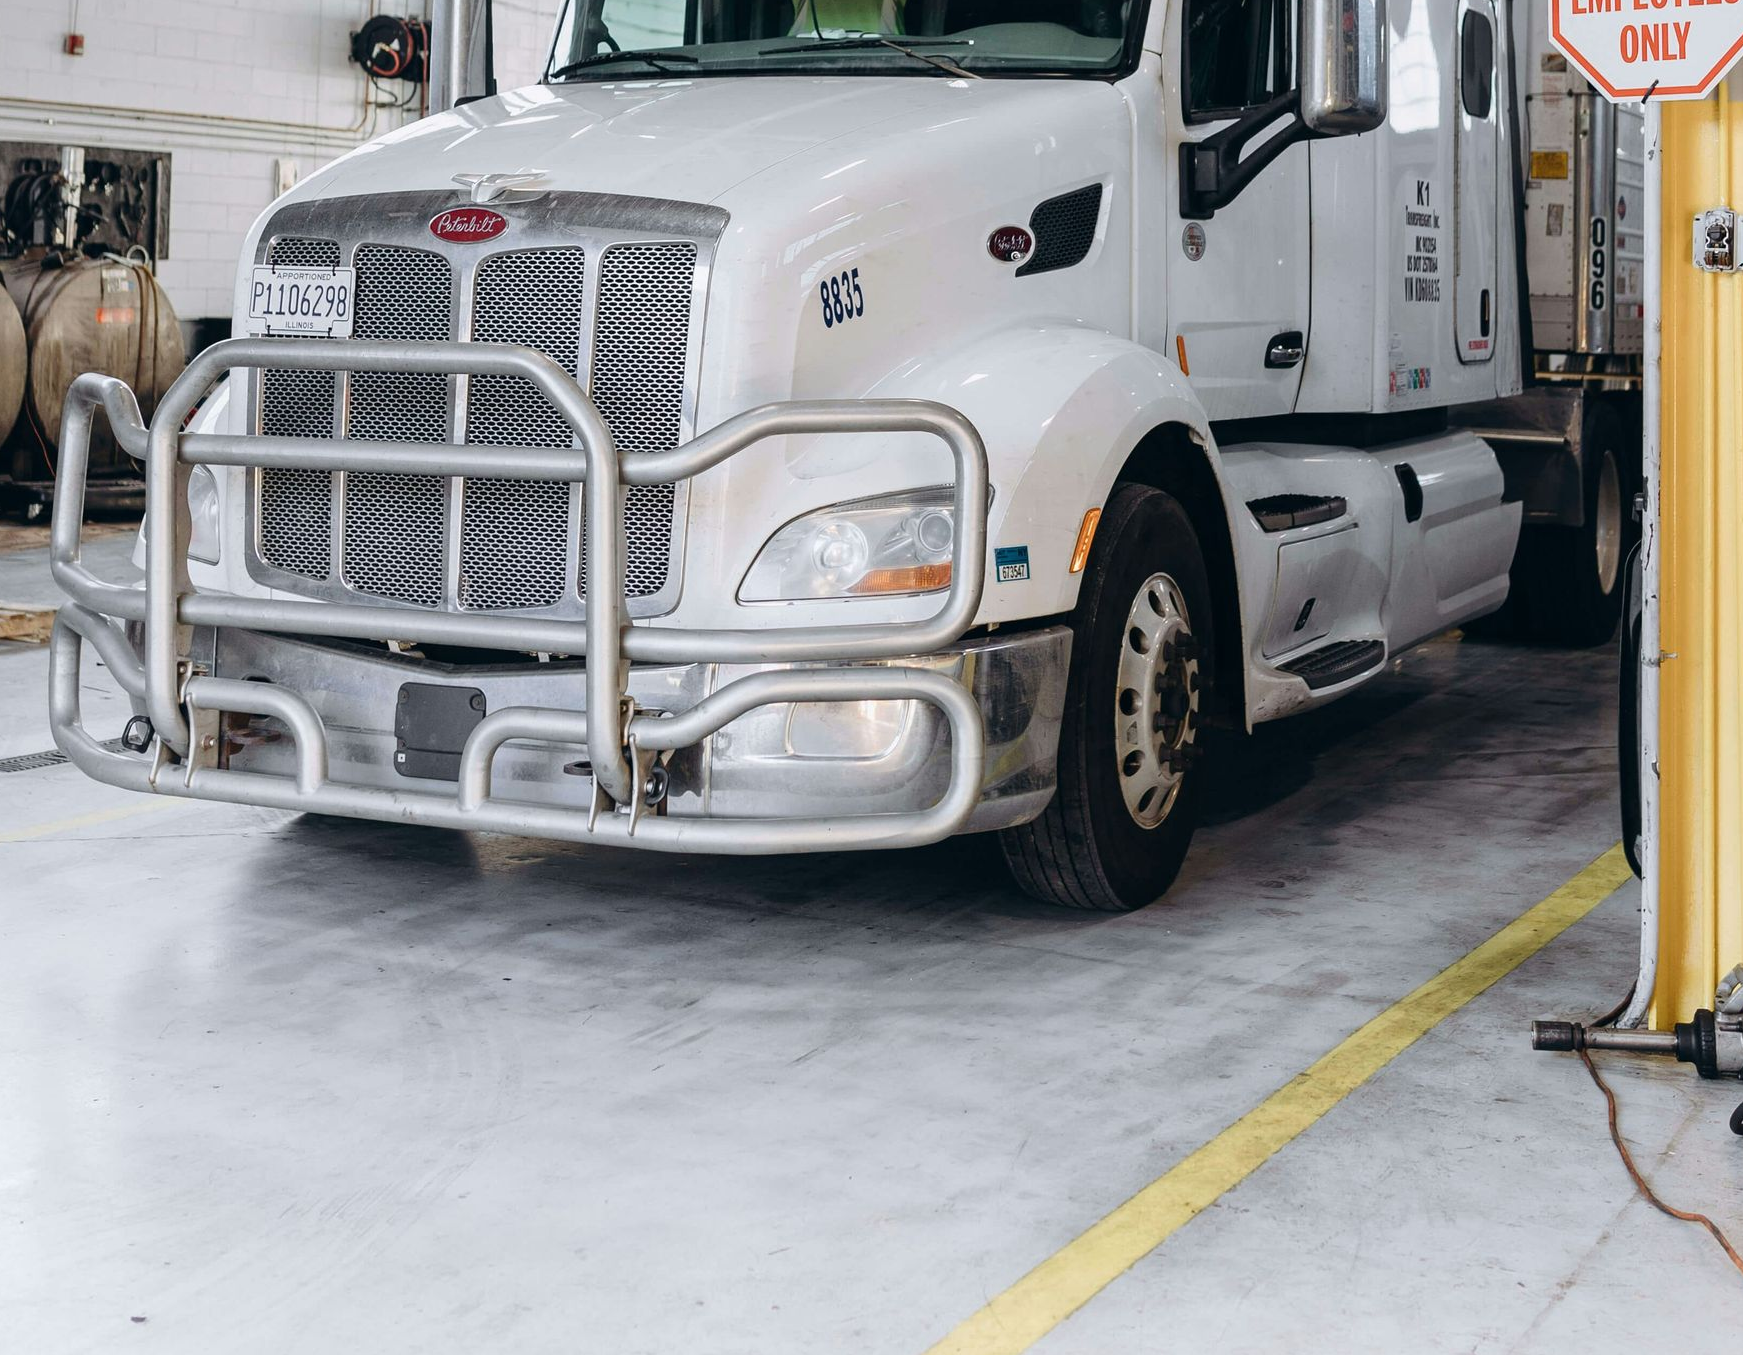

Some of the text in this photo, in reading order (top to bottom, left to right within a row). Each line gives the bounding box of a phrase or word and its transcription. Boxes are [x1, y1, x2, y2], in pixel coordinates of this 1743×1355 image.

[1619, 21, 1691, 64] ONLY
[1417, 180, 1430, 207] K1
[437, 213, 501, 234] Peterbilt
[276, 272, 332, 281] APPORTIONED
[1591, 217, 1605, 310] 096
[252, 281, 348, 318] P1106298
[820, 267, 864, 328] 8835
[285, 321, 314, 330] ILLINOIS
[1002, 564, 1025, 579] 673547
